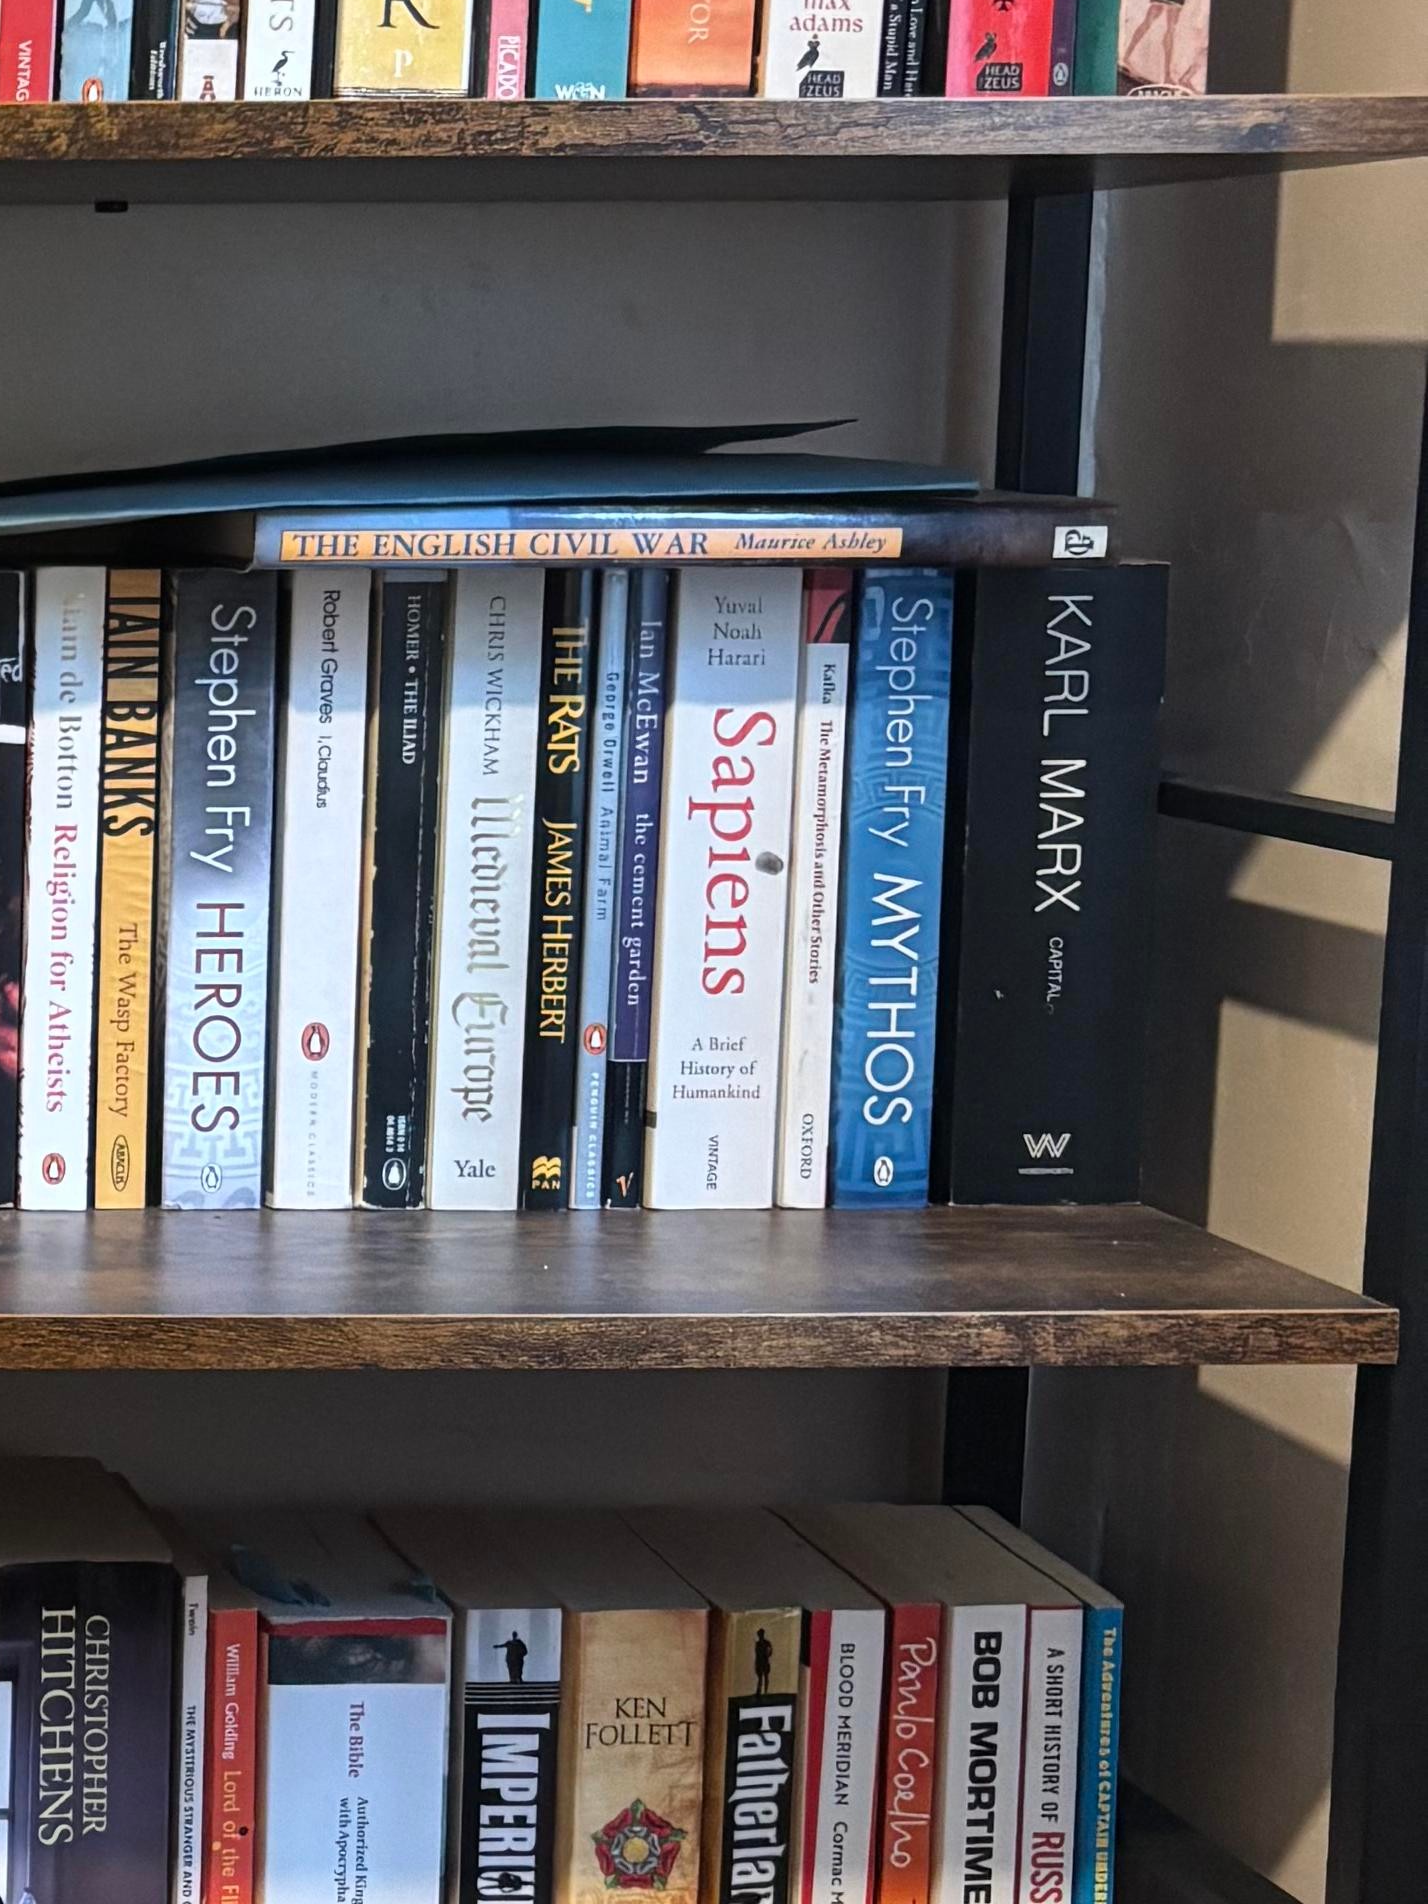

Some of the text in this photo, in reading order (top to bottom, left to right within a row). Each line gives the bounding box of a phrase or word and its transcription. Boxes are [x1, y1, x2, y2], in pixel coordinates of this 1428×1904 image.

[293, 532, 708, 558] THE ENGLISH CIVIL WAR
[734, 531, 887, 554] Maurice Ashley
[714, 596, 763, 614] Yuval
[713, 622, 762, 641] Noah
[707, 648, 766, 667] Harari
[1033, 595, 1095, 914] KARL MARX
[687, 708, 776, 997] Sapiens
[189, 604, 257, 1134] Stephen Fry HEROES
[454, 1159, 495, 1180] Yale
[971, 1631, 1003, 1708] BOB
[836, 1642, 856, 1806] BLOOD MERIDIAN
